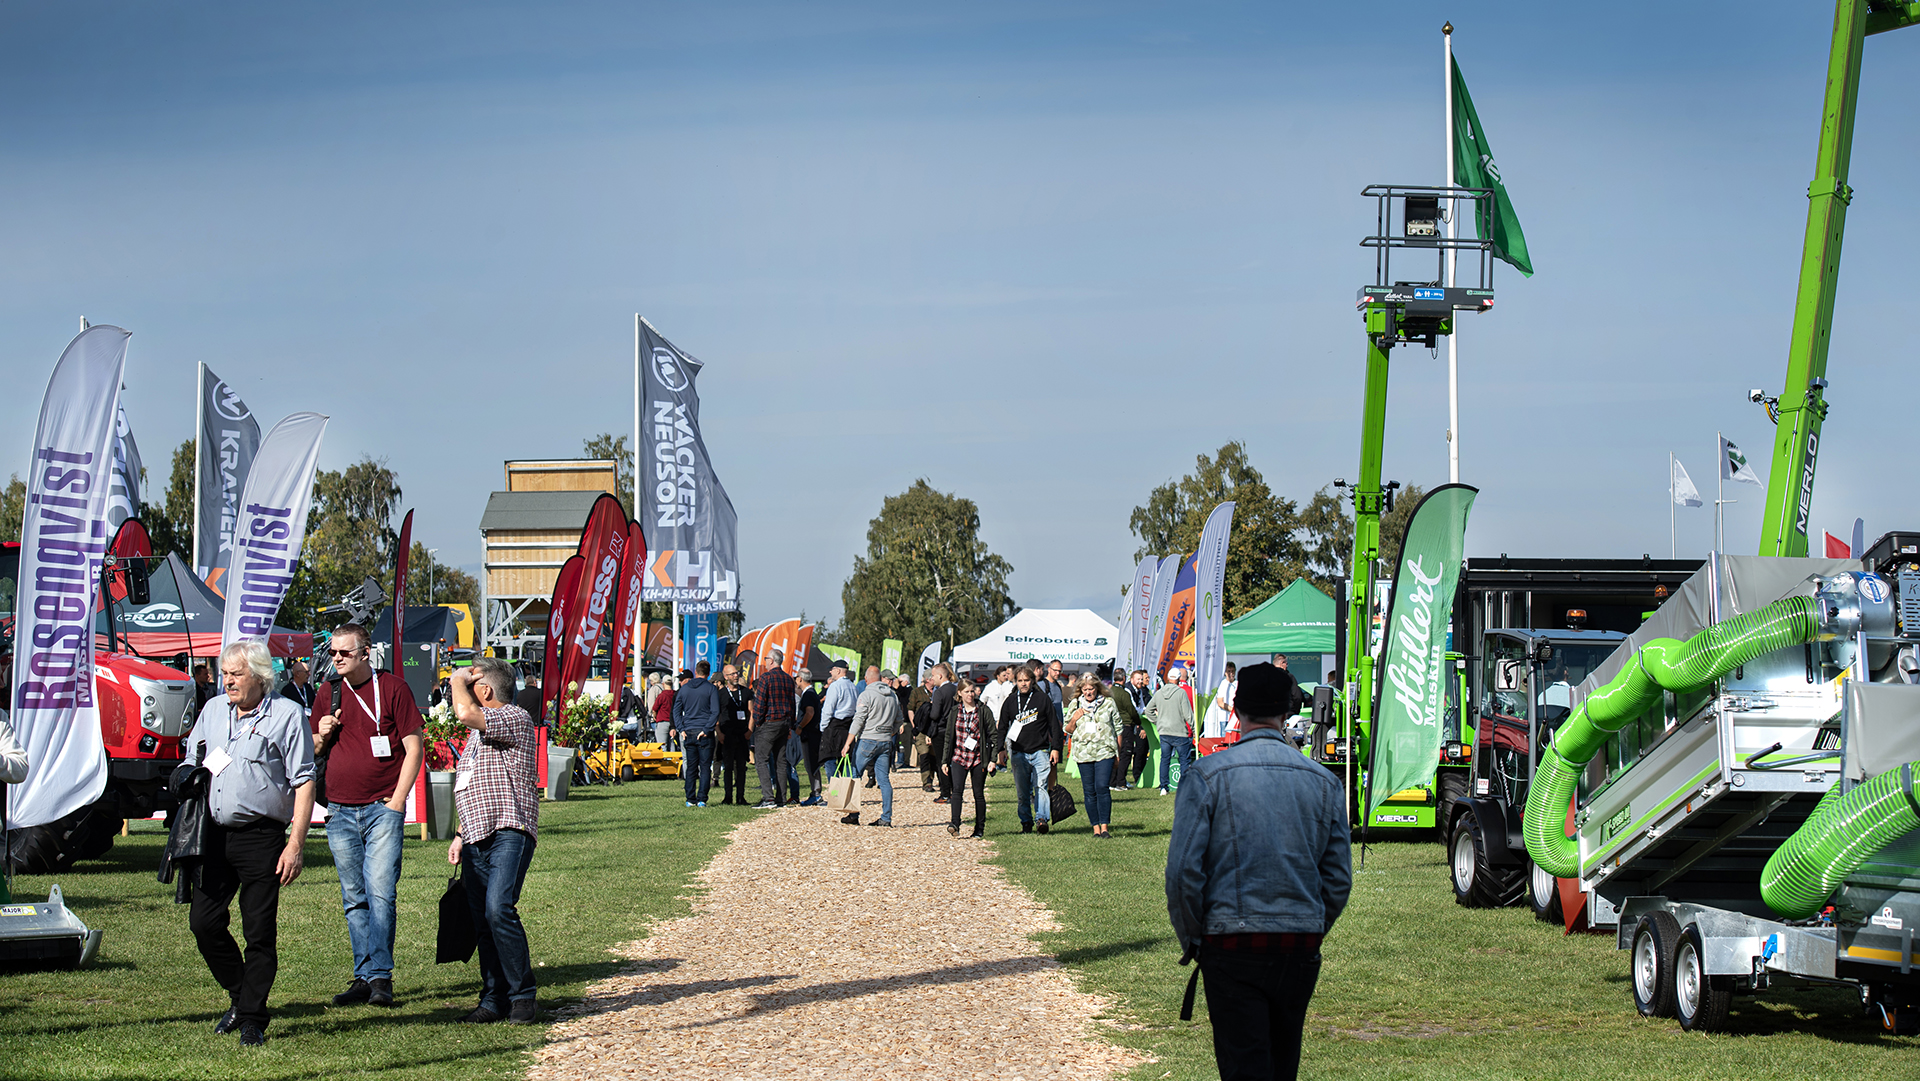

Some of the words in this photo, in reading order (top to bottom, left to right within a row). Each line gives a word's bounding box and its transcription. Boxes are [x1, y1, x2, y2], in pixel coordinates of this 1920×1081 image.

[218, 429, 241, 553] KRAMER
[653, 400, 677, 527] NEUSON
[674, 402, 696, 527] WACKER
[1797, 433, 1818, 533] MERLO
[18, 447, 105, 709] Rosenqvist
[117, 611, 197, 622] CRAMER
[238, 503, 293, 641] enqvist
[574, 555, 617, 657] Kress
[641, 588, 711, 599] KH-MASKIN
[678, 601, 737, 613] KH-MASKIN
[1005, 635, 1090, 645] Belrobotics
[1008, 651, 1035, 659] Tidab
[1042, 651, 1105, 660] www.tidab.se
[1160, 601, 1191, 678] Dipperfox
[1424, 645, 1441, 728] Maskin
